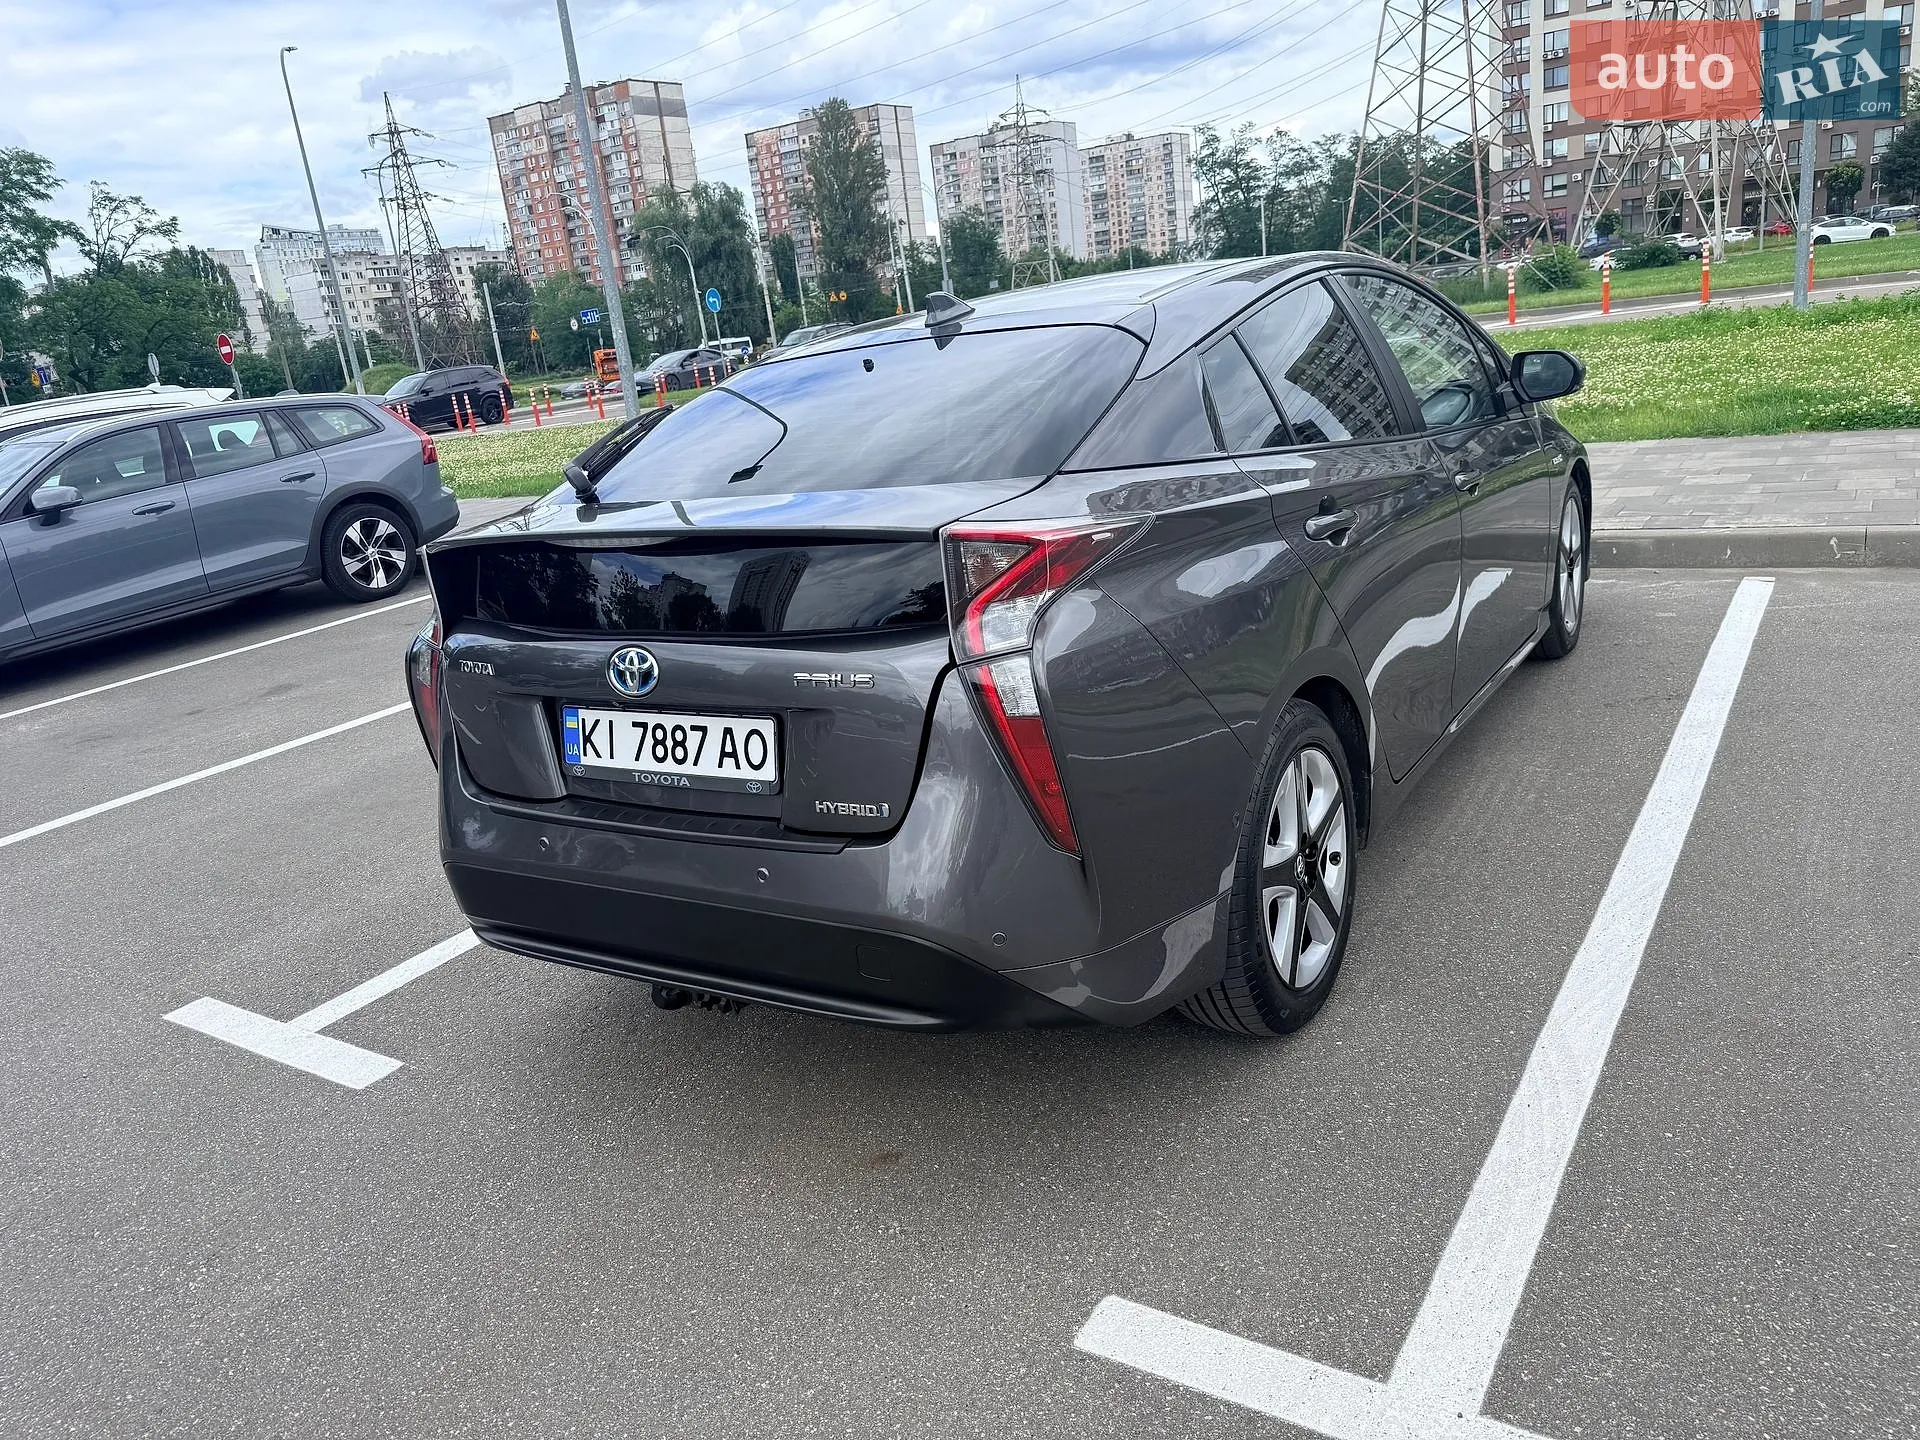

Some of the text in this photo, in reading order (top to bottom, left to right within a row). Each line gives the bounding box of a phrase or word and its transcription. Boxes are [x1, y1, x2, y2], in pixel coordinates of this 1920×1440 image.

[459, 660, 496, 676] TOYOTA
[793, 672, 875, 689] PRIUS
[567, 743, 580, 756] UA
[581, 717, 769, 771] KI 7887 AO
[632, 772, 691, 787] TOYOTA
[815, 800, 880, 817] HYBRID
